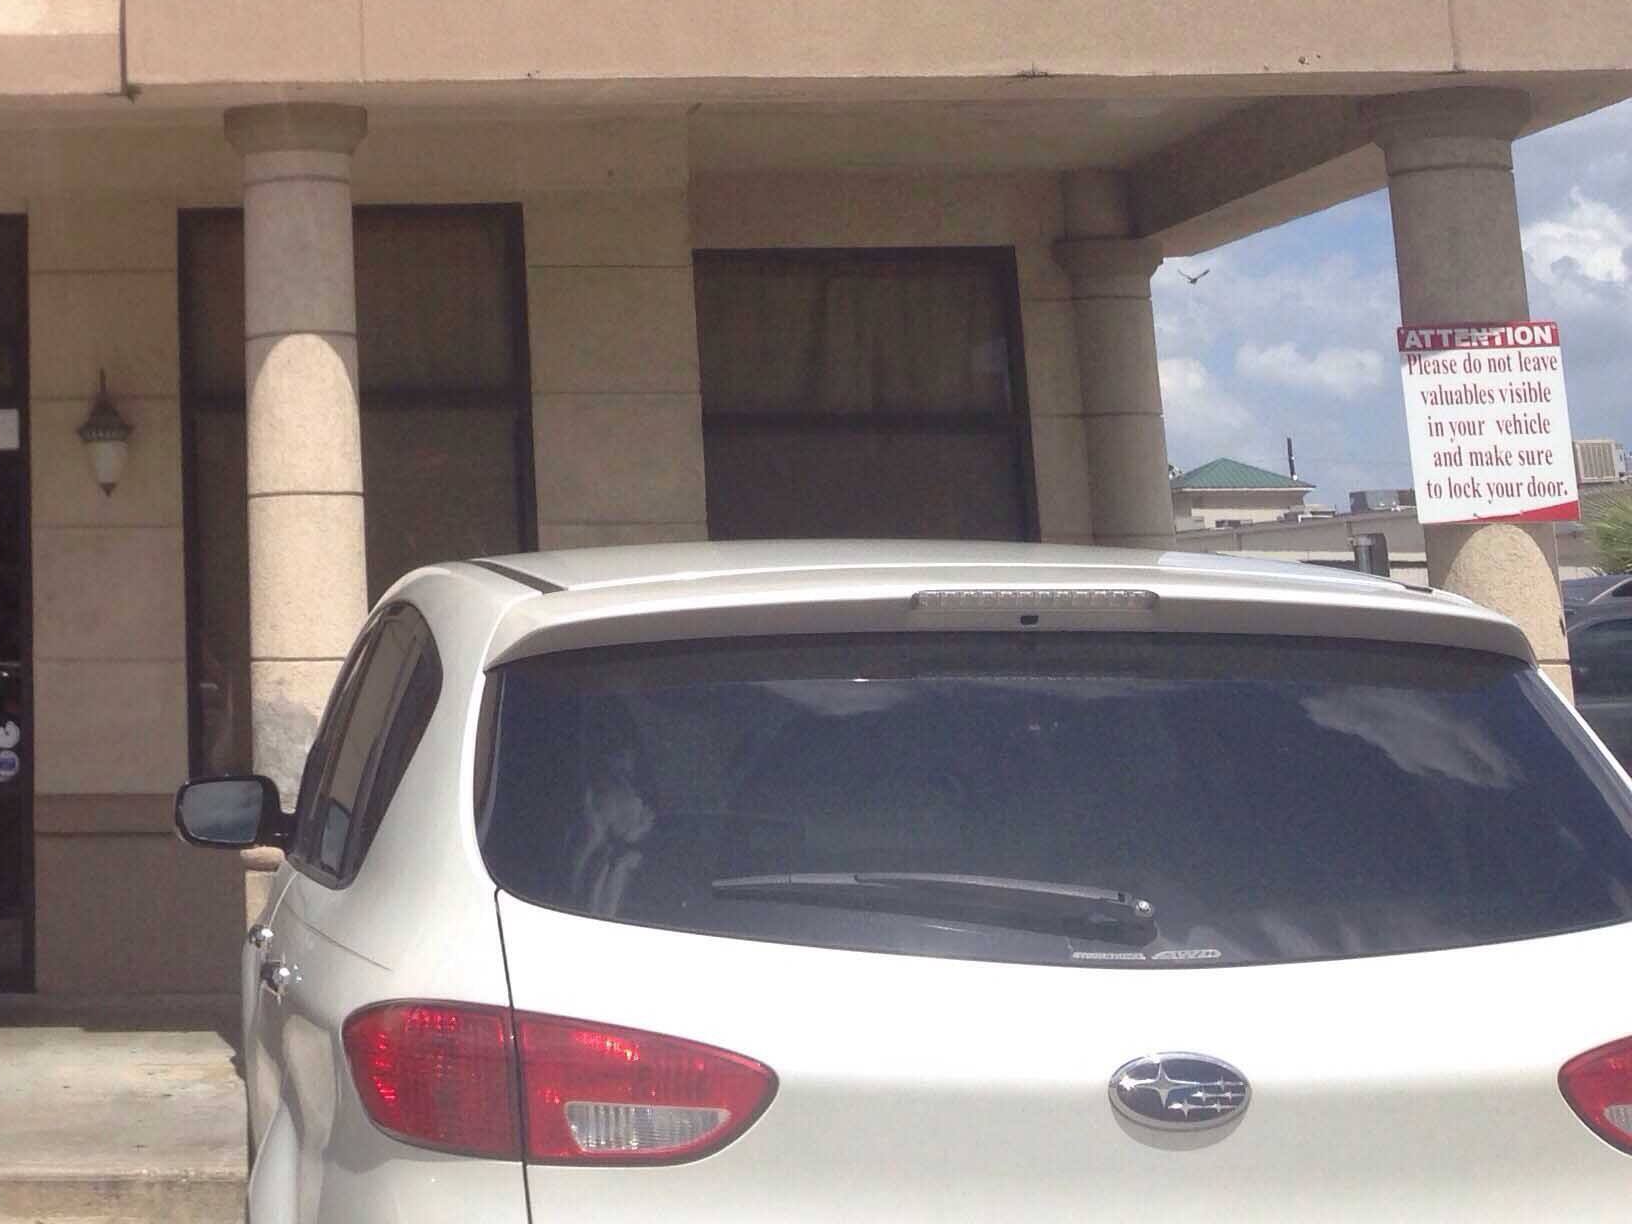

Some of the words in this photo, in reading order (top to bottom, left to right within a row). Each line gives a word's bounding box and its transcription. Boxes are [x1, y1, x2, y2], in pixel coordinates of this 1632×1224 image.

[1404, 326, 1553, 349] ATTENTION
[1406, 353, 1457, 376] Please
[1463, 352, 1482, 374] do
[1487, 354, 1512, 373] not
[1518, 351, 1558, 372] leave
[1421, 384, 1495, 407] valuables
[1499, 381, 1552, 404] visible
[1428, 416, 1444, 437] in
[1450, 418, 1485, 443] your
[1496, 412, 1551, 435] vehicle
[1433, 445, 1463, 467] and
[1469, 444, 1513, 467] make
[1518, 449, 1553, 466] sure
[1427, 480, 1443, 499] to
[1448, 476, 1483, 499] lock
[1487, 481, 1523, 504] your
[1527, 475, 1568, 498] door.
